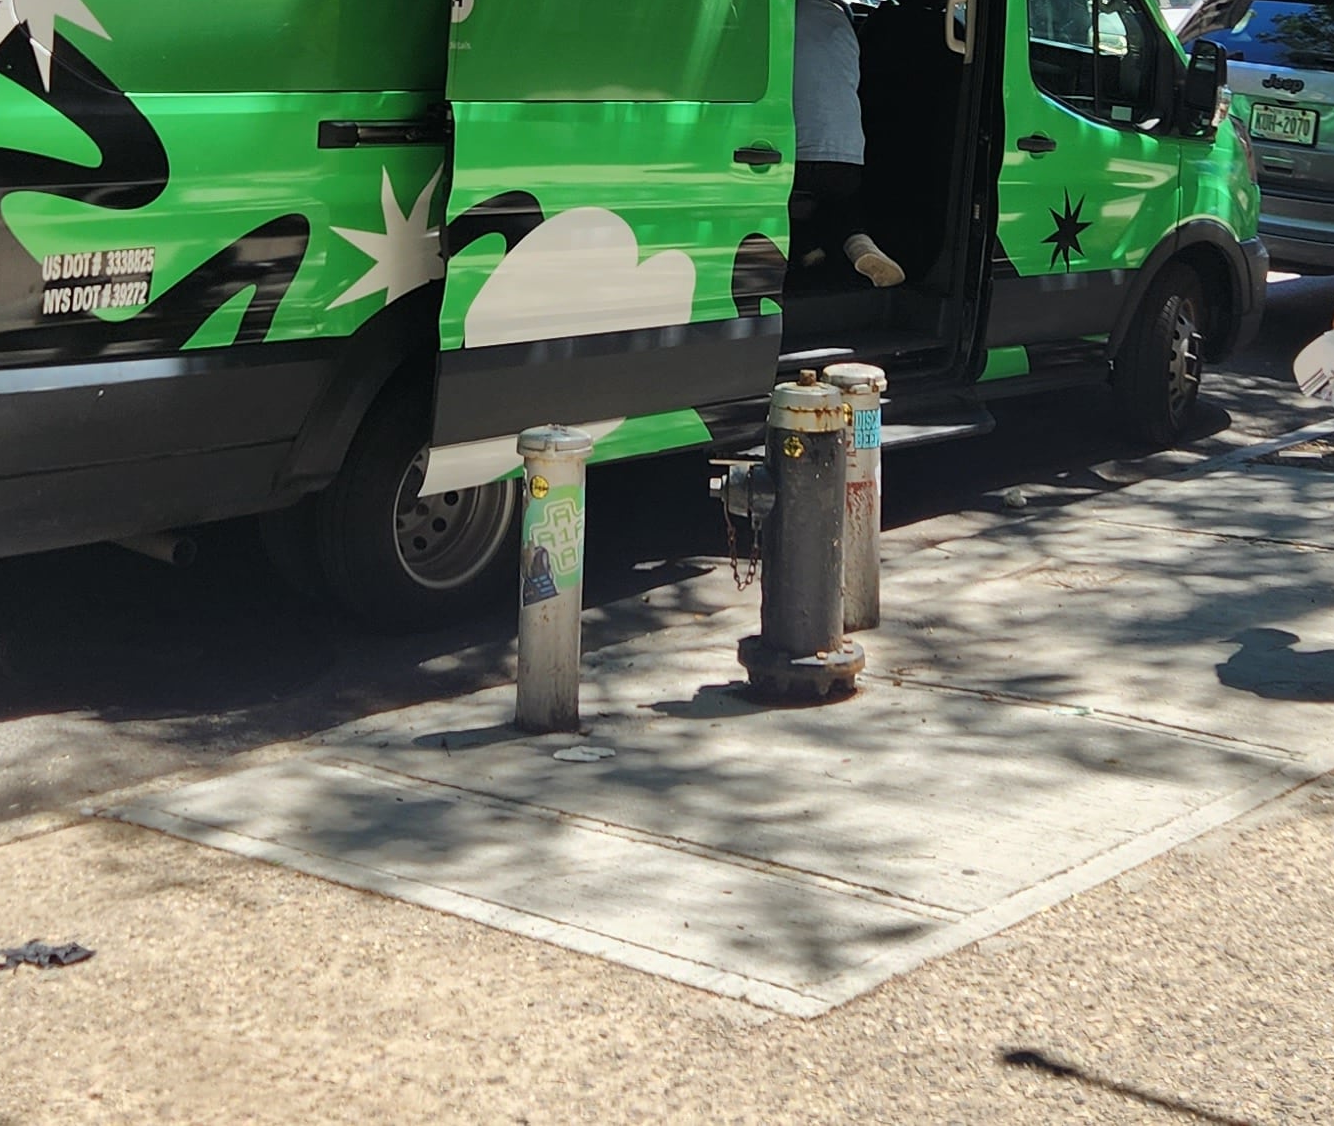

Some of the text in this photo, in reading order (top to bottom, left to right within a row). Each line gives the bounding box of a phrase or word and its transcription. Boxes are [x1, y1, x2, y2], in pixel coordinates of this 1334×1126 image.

[1262, 73, 1305, 95] Jeep
[42, 255, 62, 282] US
[62, 252, 92, 280] DOT
[43, 287, 72, 315] NYS
[71, 285, 102, 313] DOT
